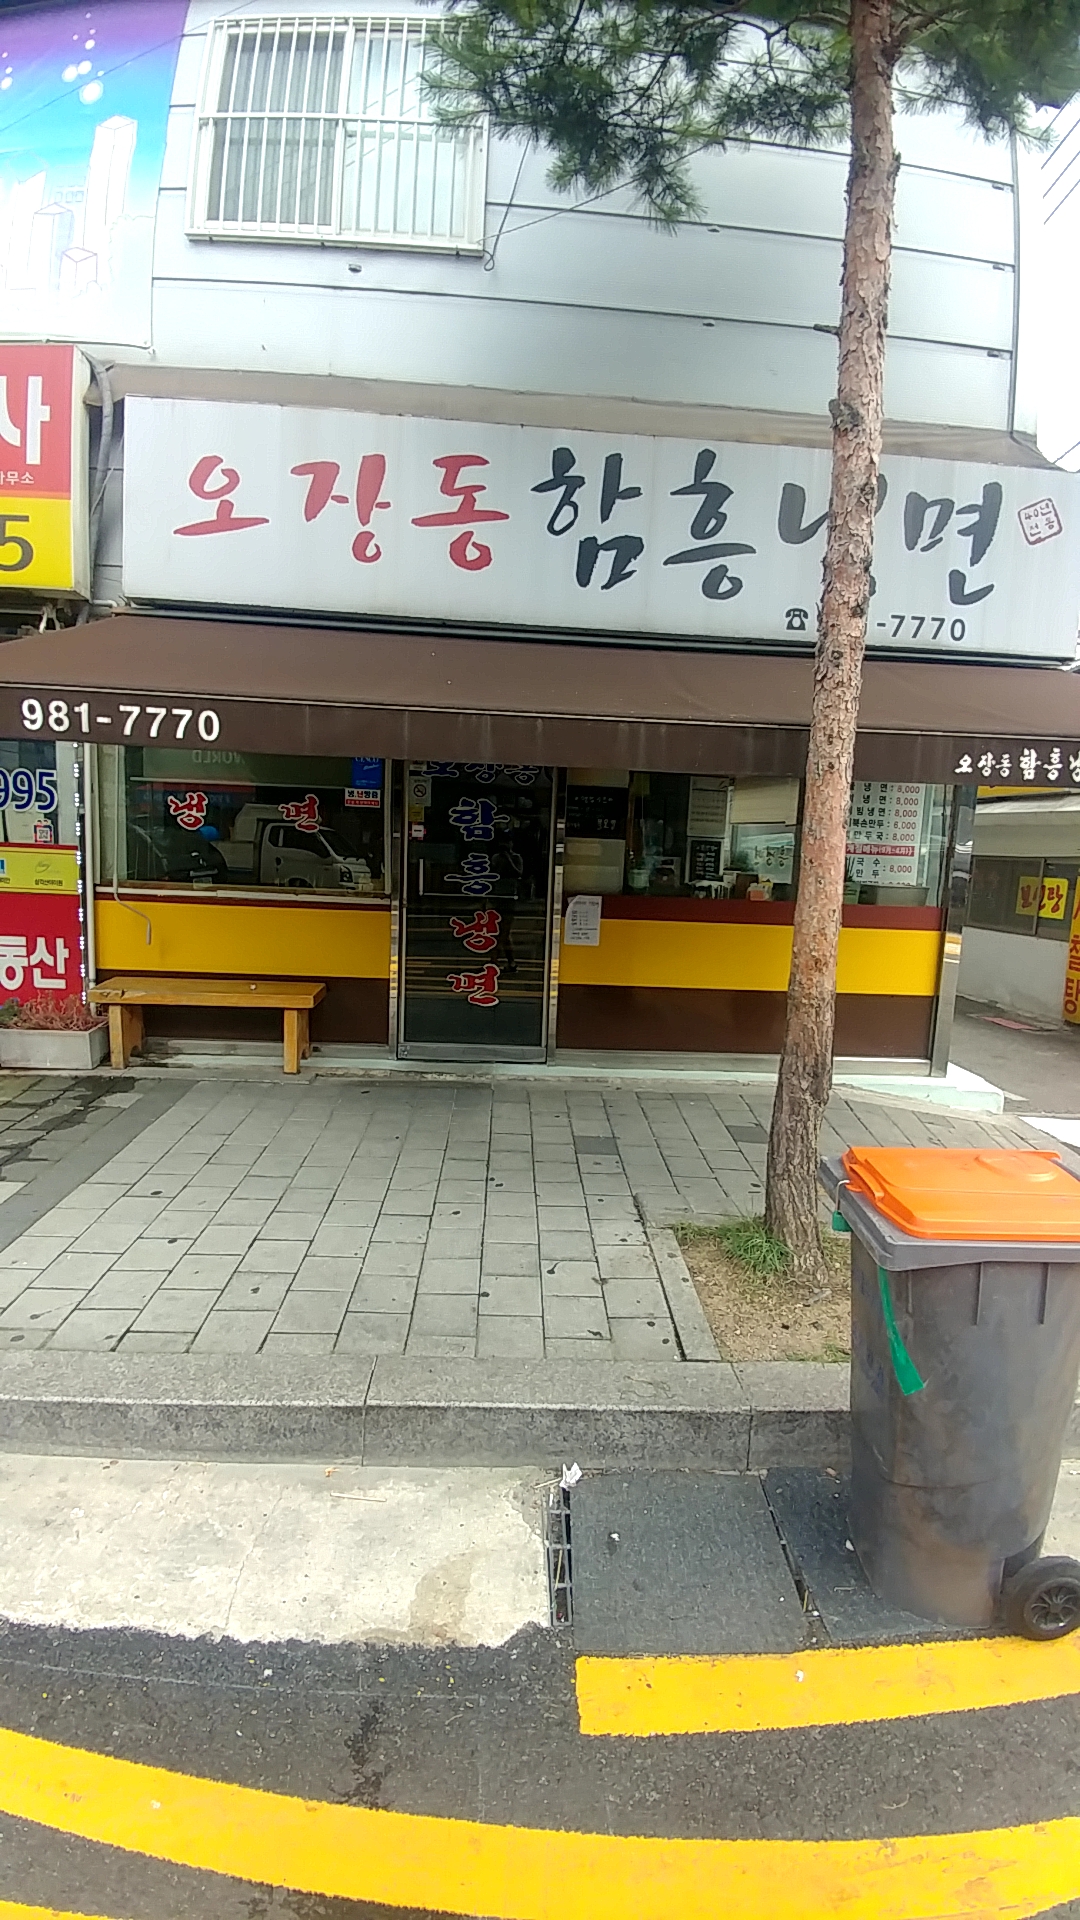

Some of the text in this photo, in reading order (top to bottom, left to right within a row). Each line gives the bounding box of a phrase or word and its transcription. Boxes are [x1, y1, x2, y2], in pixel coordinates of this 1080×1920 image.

[0, 470, 35, 486] 무소
[21, 698, 222, 742] 981-7770
[954, 751, 1013, 778] 오장동
[895, 797, 919, 806] 8,000
[894, 809, 918, 818] 8,000
[893, 821, 917, 830] 6,000
[892, 833, 915, 842] 8,000
[889, 865, 913, 874] 8,000
